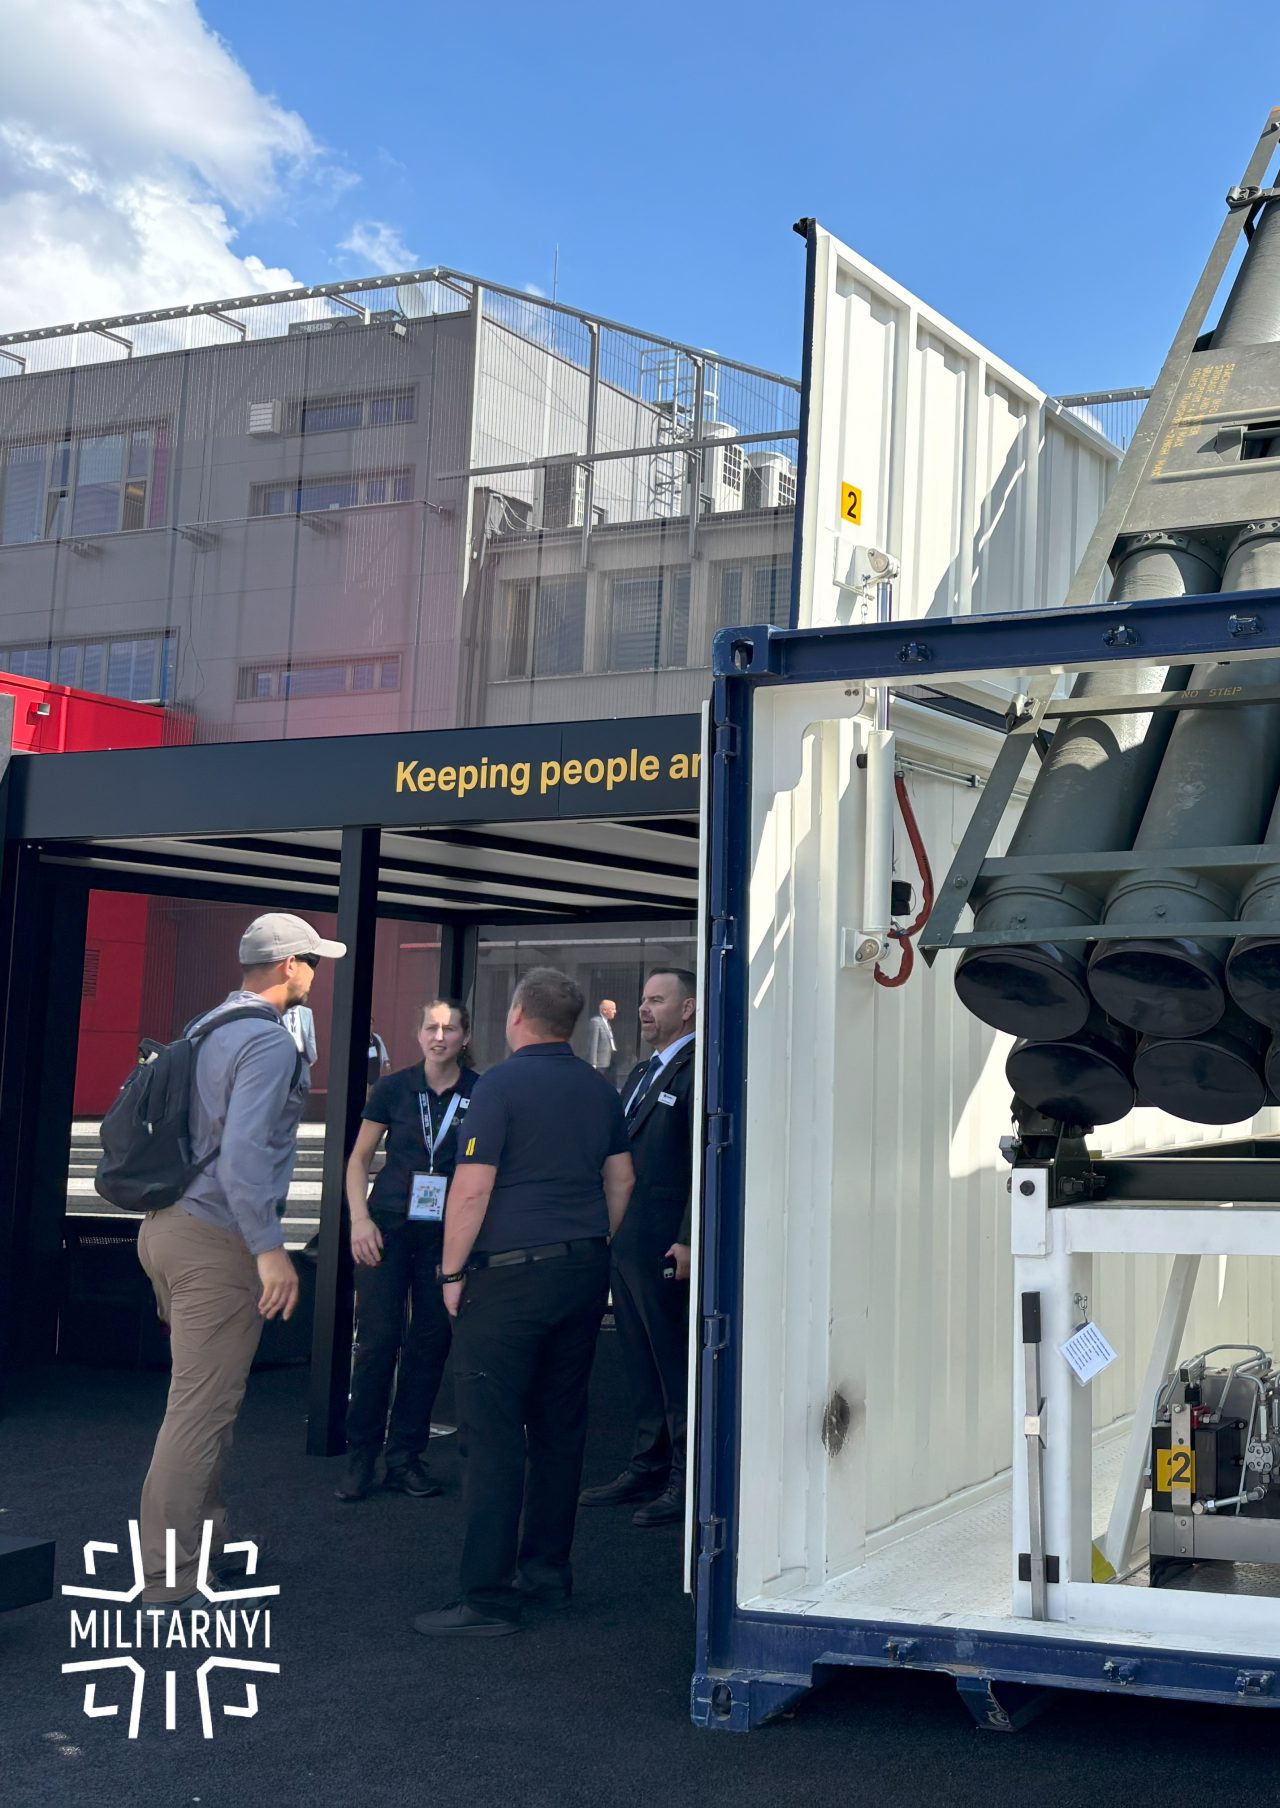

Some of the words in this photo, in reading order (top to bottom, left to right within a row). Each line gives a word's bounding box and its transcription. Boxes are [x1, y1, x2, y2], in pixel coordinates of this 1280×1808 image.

[847, 491, 857, 519] 2
[1182, 690, 1199, 698] NO
[1208, 686, 1242, 697] STEP
[396, 757, 531, 798] Keeping
[540, 748, 659, 794] people
[1172, 1451, 1191, 1483] 2
